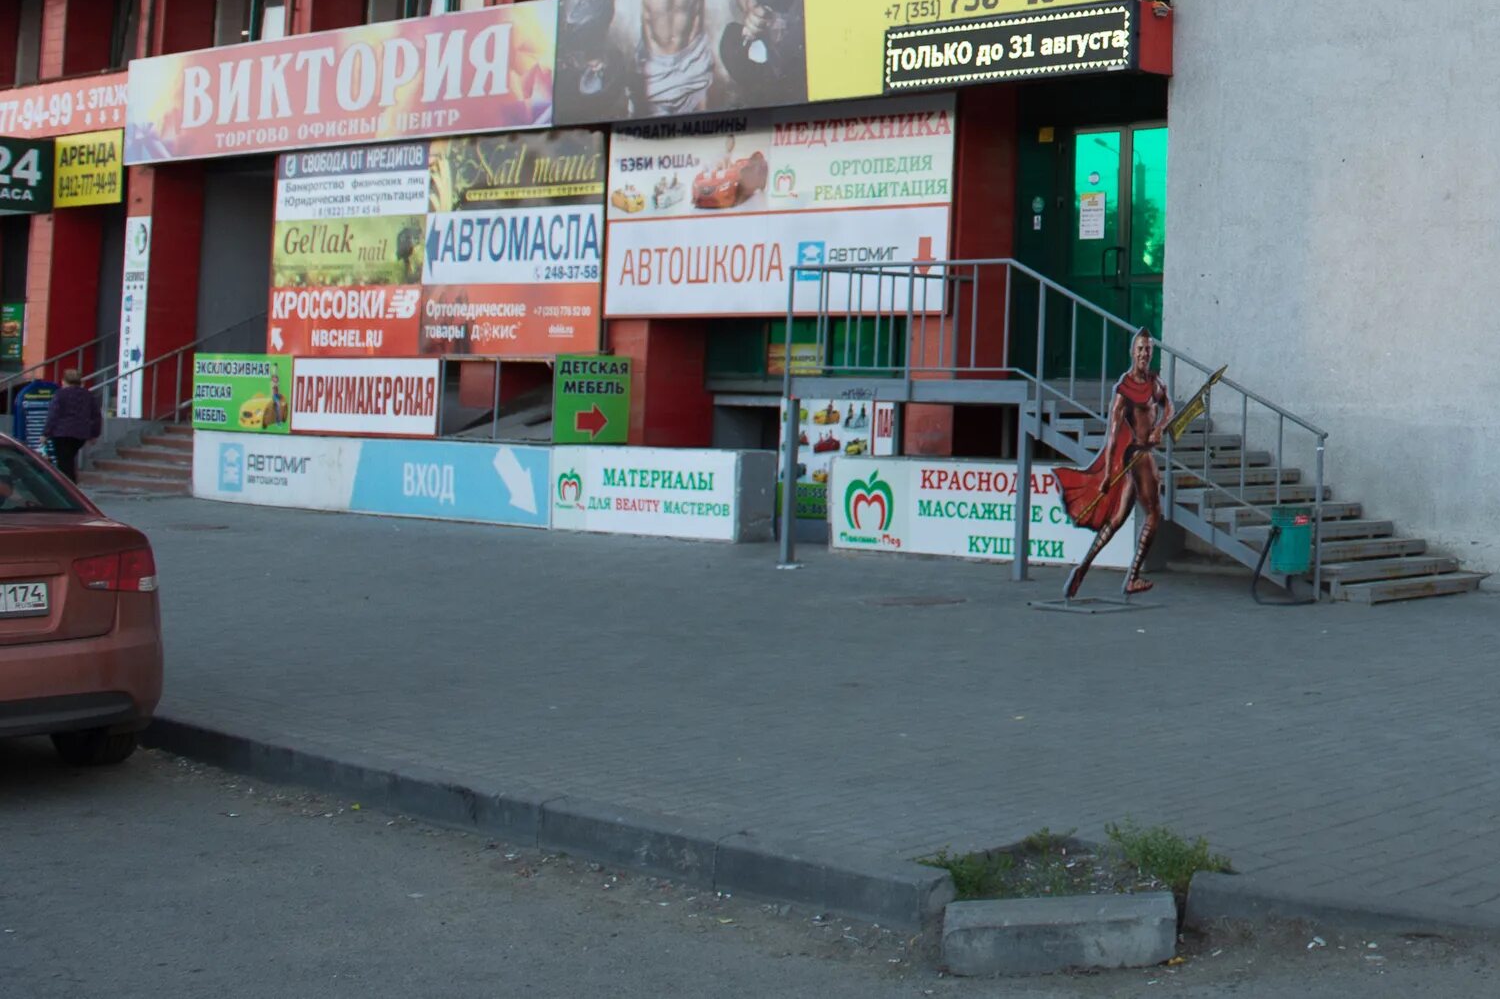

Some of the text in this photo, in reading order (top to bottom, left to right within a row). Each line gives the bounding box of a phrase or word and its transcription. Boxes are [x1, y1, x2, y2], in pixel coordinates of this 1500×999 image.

[884, 3, 901, 21] +7
[890, 28, 1126, 72] ТОЛЬКО до 31 августа
[180, 23, 513, 130] ВИКТОРИЯ
[76, 83, 128, 112] 1 ЭТАЖ
[215, 125, 289, 150] ТОРГОВО
[396, 107, 460, 134] ЦЕНТР
[773, 109, 952, 148] МЕДТЕХНИКА
[0, 146, 42, 187] 24
[59, 141, 116, 168] АРЕНДА
[301, 145, 424, 174] СВОБОДА ОТ КРЕДИТОВ
[829, 154, 933, 178] ОРТОПЕДИЯ
[532, 152, 601, 184] mania
[285, 177, 425, 193] Банкротство физических лиц
[814, 178, 949, 202] РЕАБИЛИТАЦИЯ
[285, 190, 425, 208] Юридическая консультация
[440, 213, 600, 262] АВТОМАСЛА
[358, 239, 388, 262] nail
[544, 265, 599, 280] 248-37-58
[619, 242, 899, 287] АВТОШКОЛА АВТОМИГ
[272, 290, 386, 320] КРОССОВКИ
[426, 301, 526, 321] Ортопедические
[311, 328, 383, 348] NBCHEL.RU
[424, 323, 466, 341] товары
[196, 360, 270, 377] ЭКСКЛЮЗИВНАЯ
[560, 360, 629, 375] ДЕТСКАЯ
[195, 383, 232, 400] ДЕТСКАЯ
[295, 375, 435, 417] ПАРИКМАХЕРСКАЯ
[563, 380, 625, 395] МЕБЕЛЬ
[194, 407, 227, 423] МЕБЕЛЬ
[248, 453, 311, 474] АВТОМИГ
[403, 462, 455, 506] ВХОД
[602, 467, 714, 491] МАТЕРИАЛЫ
[920, 469, 1061, 496] КРАСНОДАР
[587, 496, 612, 511] ДЛЯ
[615, 497, 661, 513] BEAUTY
[663, 501, 730, 517] МАСТЕРОВ
[918, 499, 1043, 524] МАССАЖНЕ
[968, 535, 1064, 558] КУШТКИ
[8, 585, 43, 603] 174
